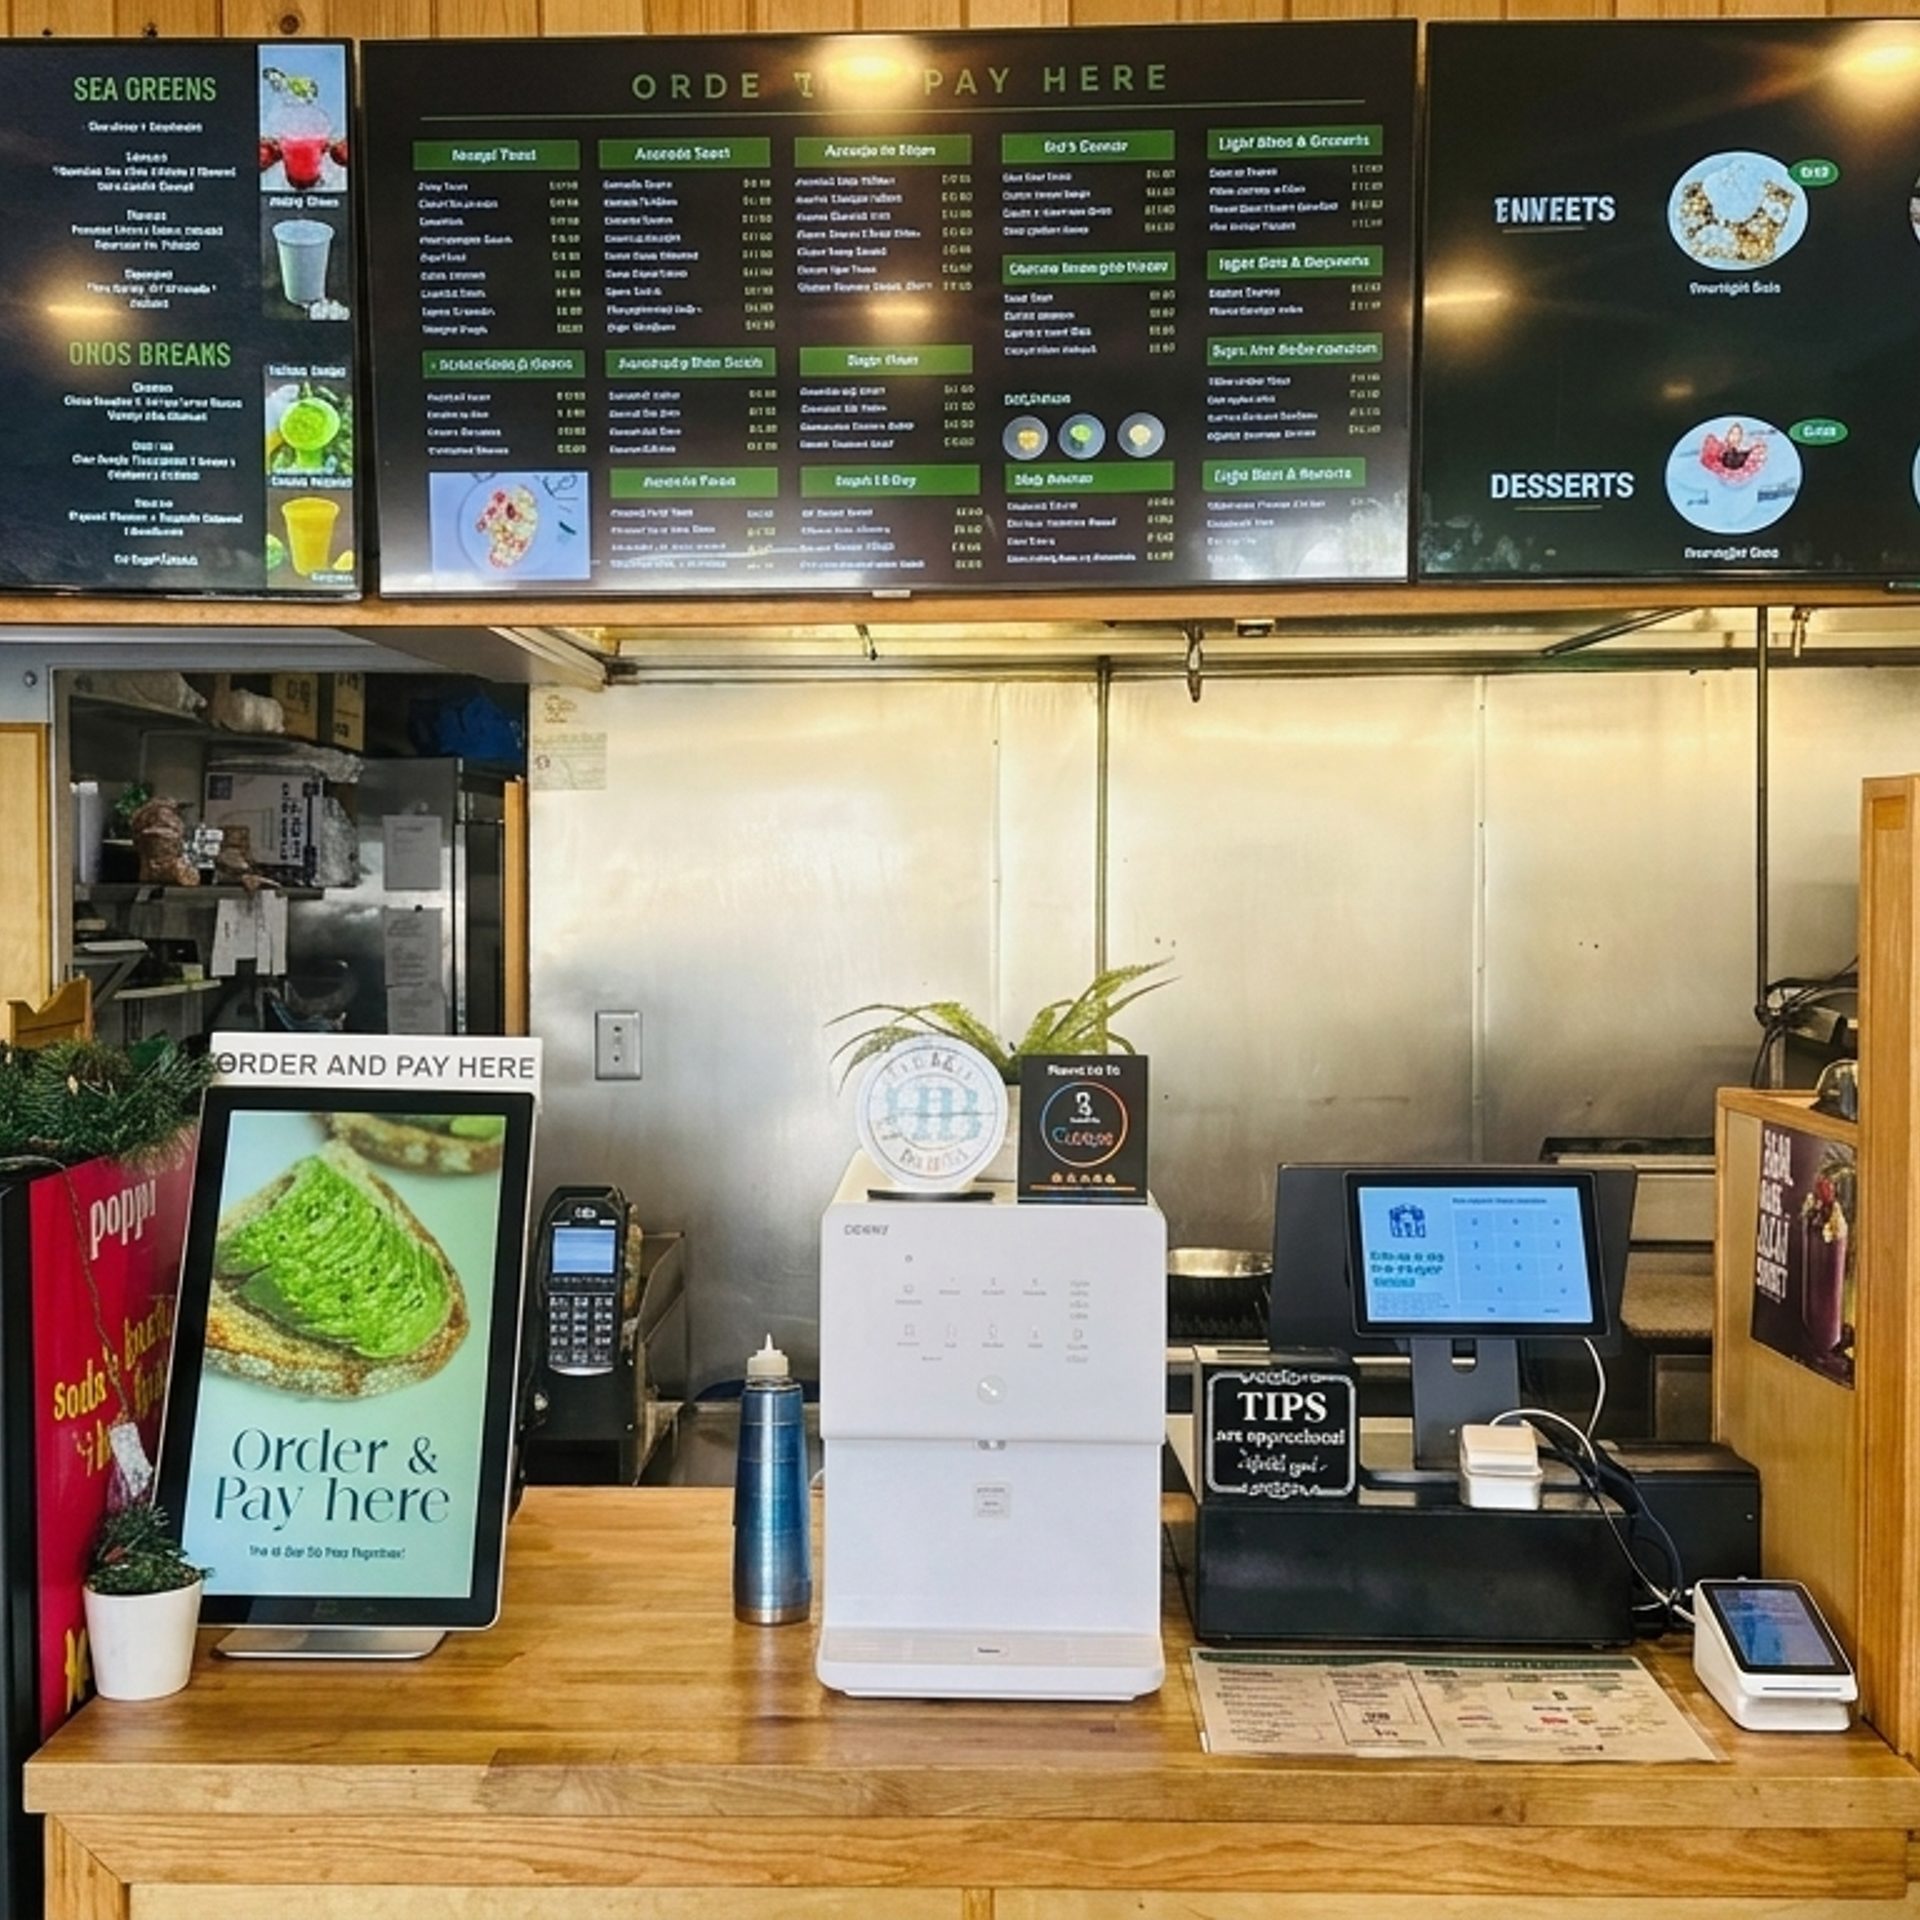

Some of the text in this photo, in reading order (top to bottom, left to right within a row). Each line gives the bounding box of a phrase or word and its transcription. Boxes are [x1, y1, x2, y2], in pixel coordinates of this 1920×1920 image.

[74, 76, 217, 101] SEA GREENS
[923, 67, 1011, 96] PAY
[1043, 64, 1166, 93] HERE
[1490, 472, 1635, 500] DESSERTS
[216, 1052, 535, 1079] ORDER AND PAY HERE
[1236, 1390, 1328, 1424] TIPS
[232, 1427, 438, 1475] Order &
[214, 1476, 450, 1532] Pay here
